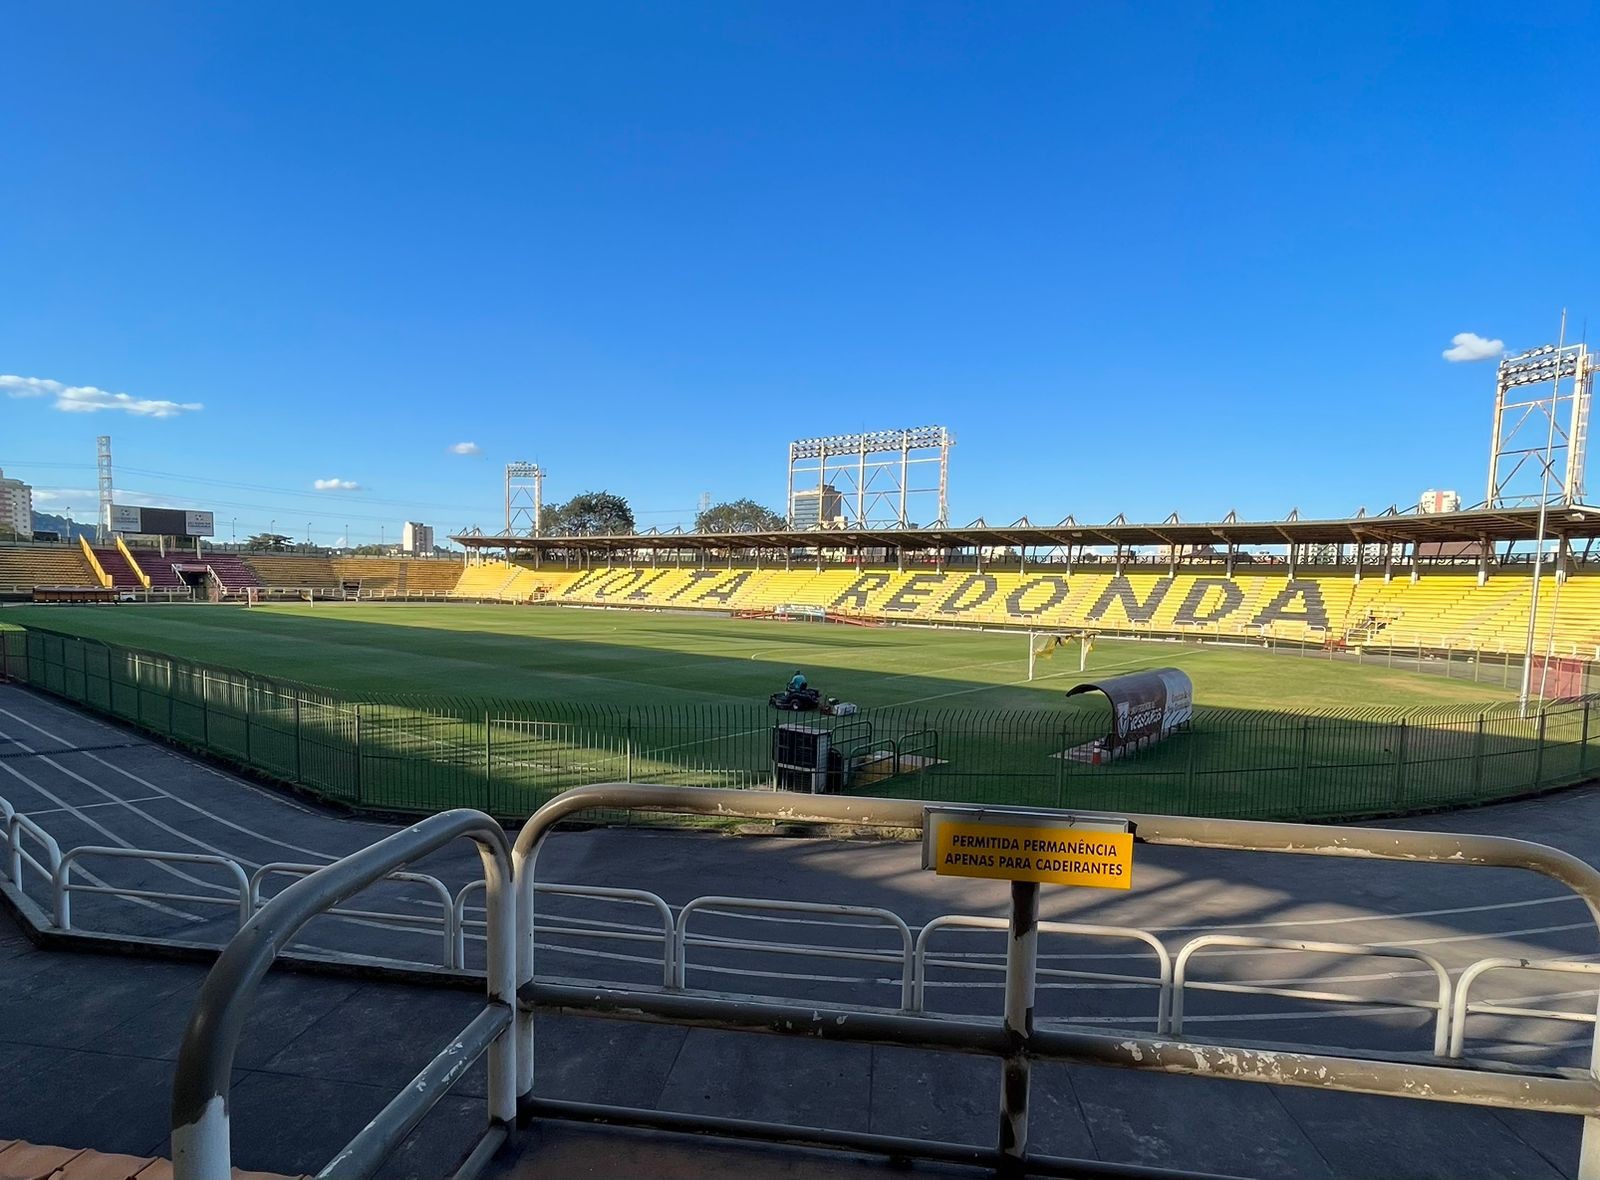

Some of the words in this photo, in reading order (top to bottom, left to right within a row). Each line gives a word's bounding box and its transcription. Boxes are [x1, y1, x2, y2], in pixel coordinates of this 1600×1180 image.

[561, 569, 754, 604] VOLTA
[833, 573, 1330, 632] REDONDA
[952, 835, 1019, 851] PERMITIDA
[1024, 838, 1117, 857] PERMANÊNCIA
[945, 853, 994, 867] APENAS
[999, 856, 1031, 870] PARA
[1036, 858, 1123, 876] CADEIRANTES
